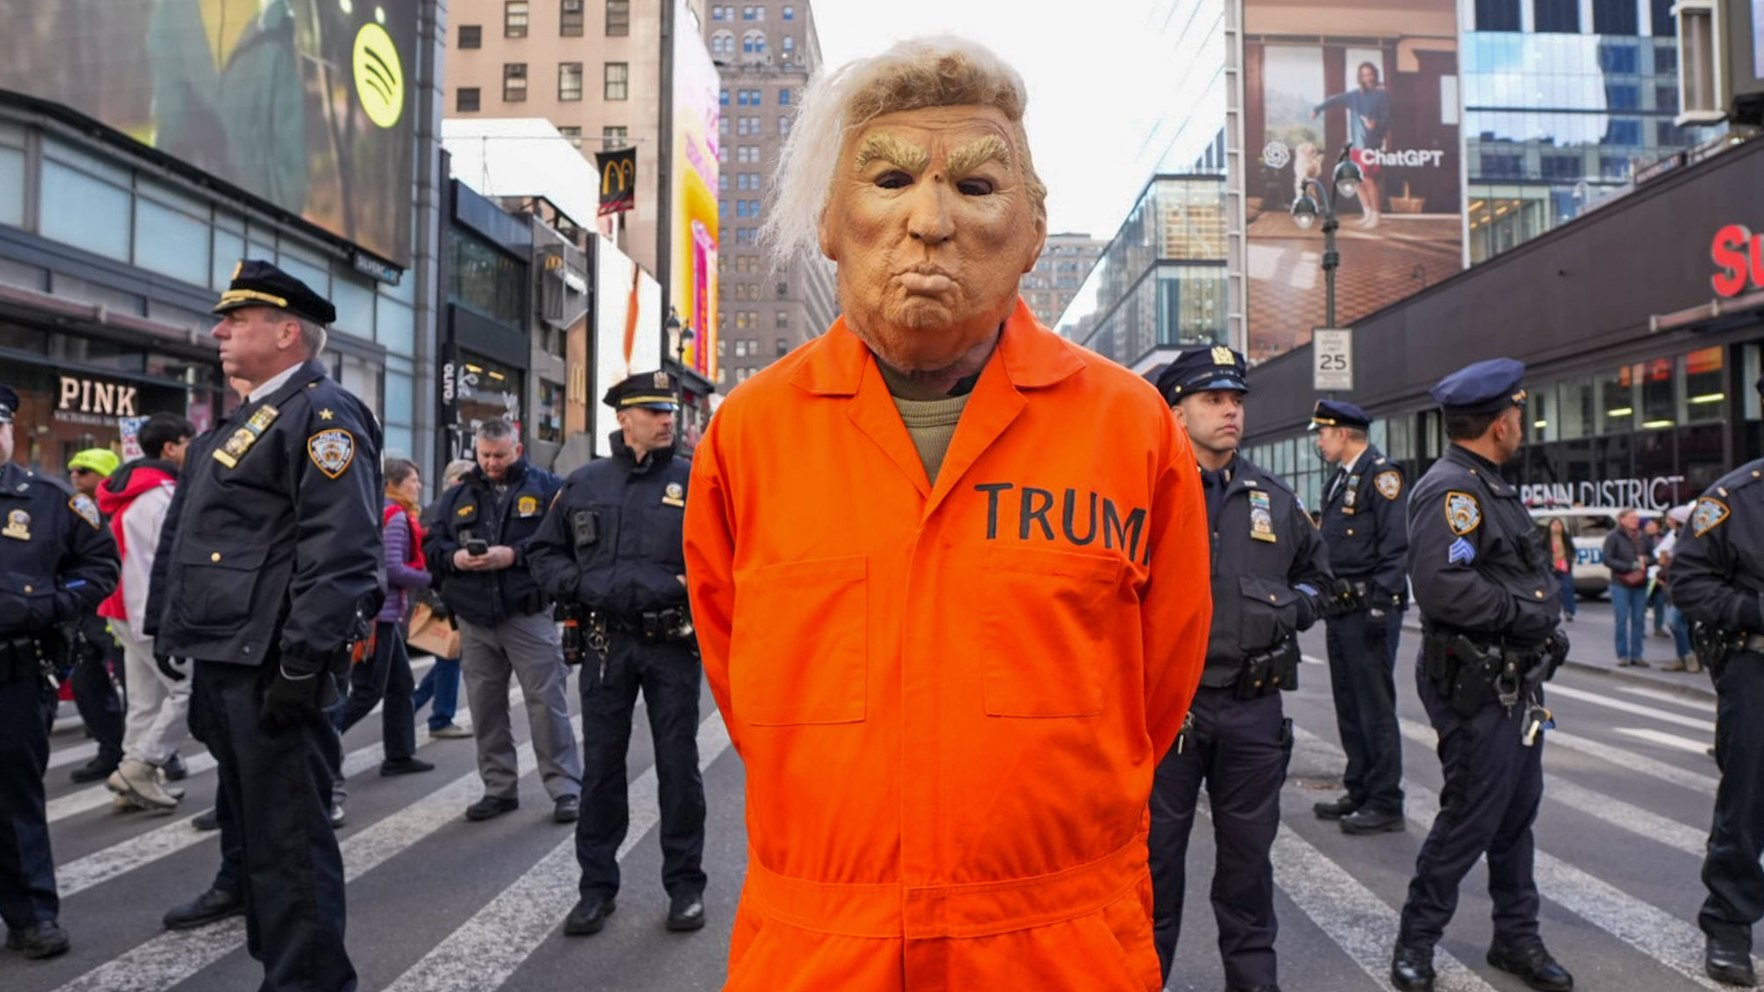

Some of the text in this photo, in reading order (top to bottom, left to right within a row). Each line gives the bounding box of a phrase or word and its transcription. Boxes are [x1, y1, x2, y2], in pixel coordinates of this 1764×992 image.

[1361, 148, 1444, 168] ChatGPT
[1320, 354, 1347, 370] 25
[59, 376, 136, 416] PINK
[1521, 475, 1685, 512] PENN DISTRICT
